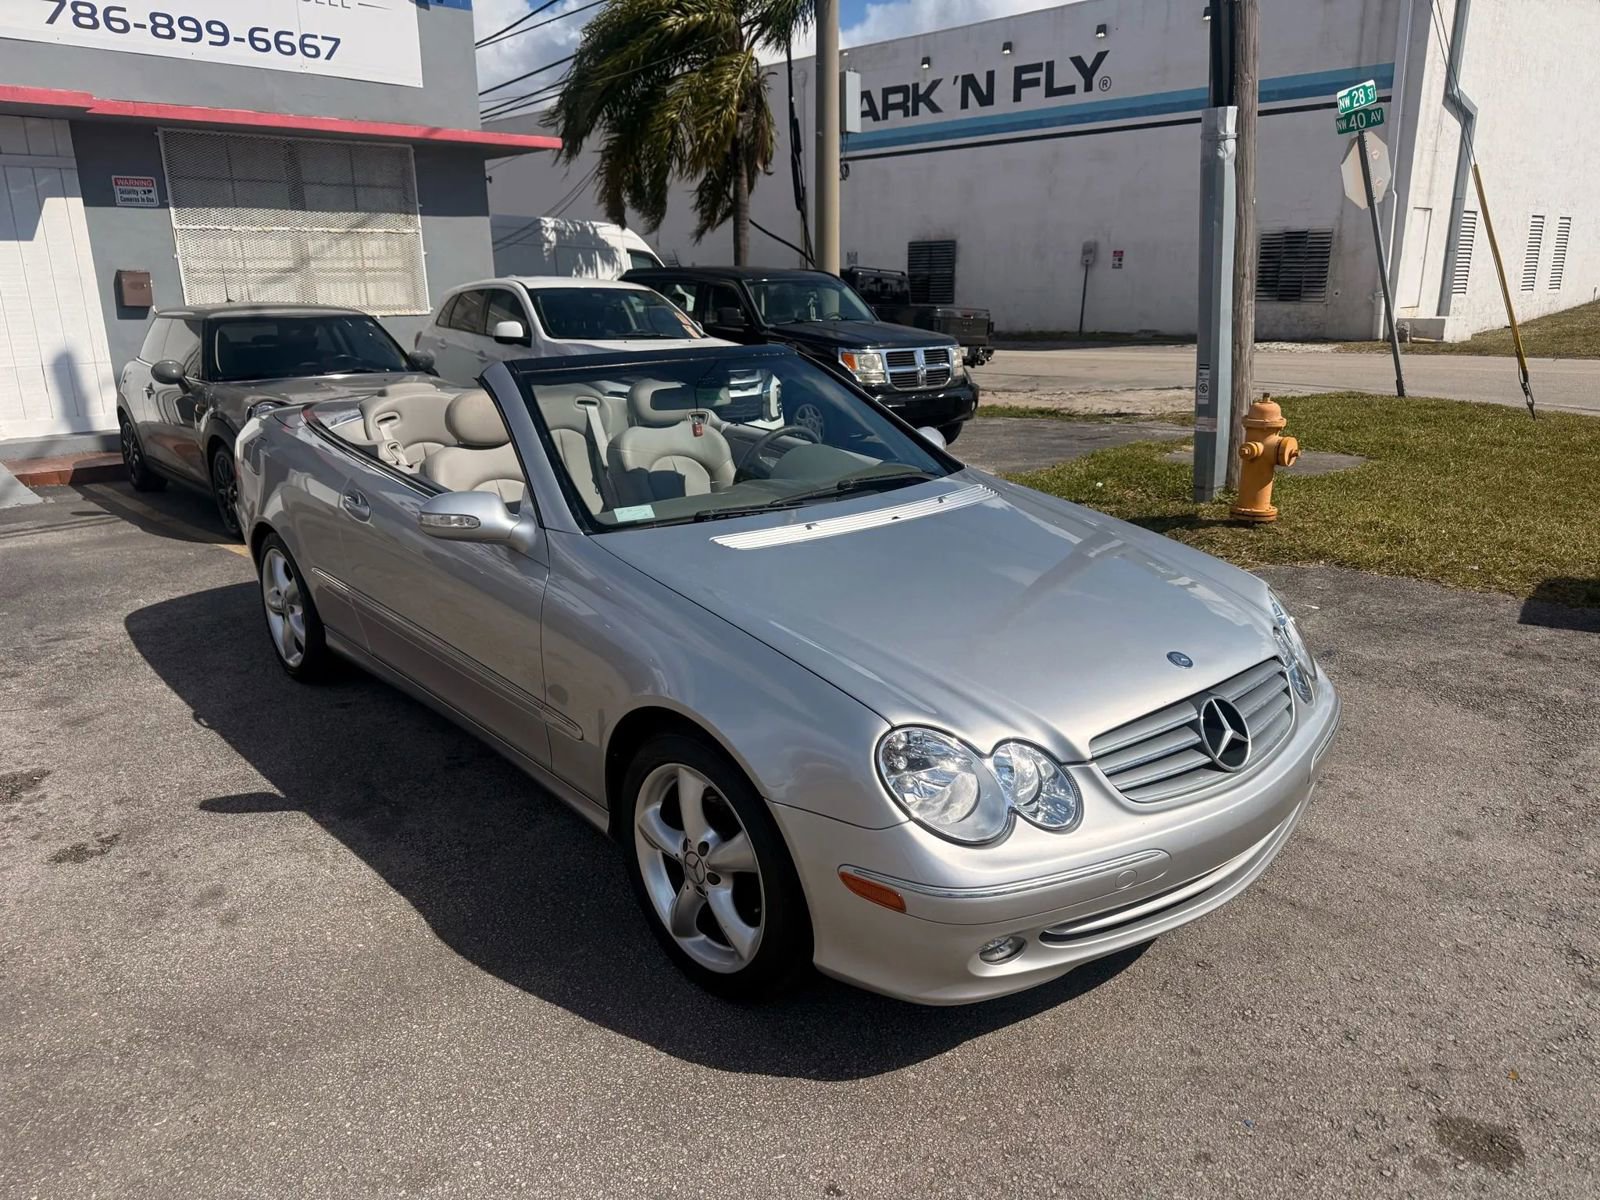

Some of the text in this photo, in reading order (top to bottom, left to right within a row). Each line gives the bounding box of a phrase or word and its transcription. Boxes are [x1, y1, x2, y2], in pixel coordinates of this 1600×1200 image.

[45, 0, 341, 61] 786-899-6667
[1339, 88, 1374, 110] NW 28 ST
[1336, 110, 1381, 130] NW 40 AV
[116, 178, 152, 187] WARNING
